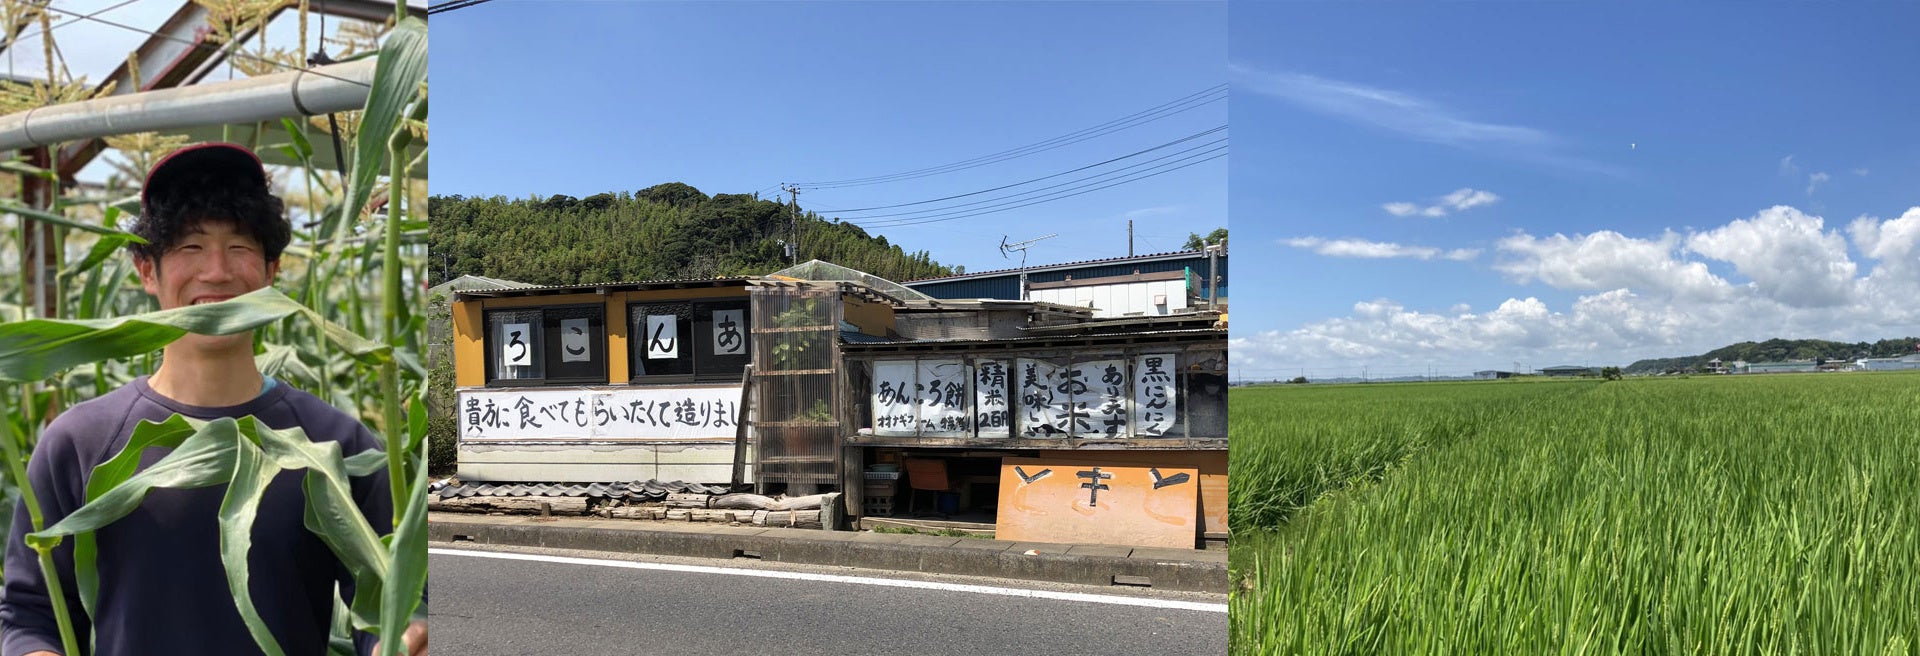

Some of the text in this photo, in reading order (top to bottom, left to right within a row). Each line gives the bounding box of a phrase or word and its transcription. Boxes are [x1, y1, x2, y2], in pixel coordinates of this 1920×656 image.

[1141, 357, 1171, 435] 黒にんにく
